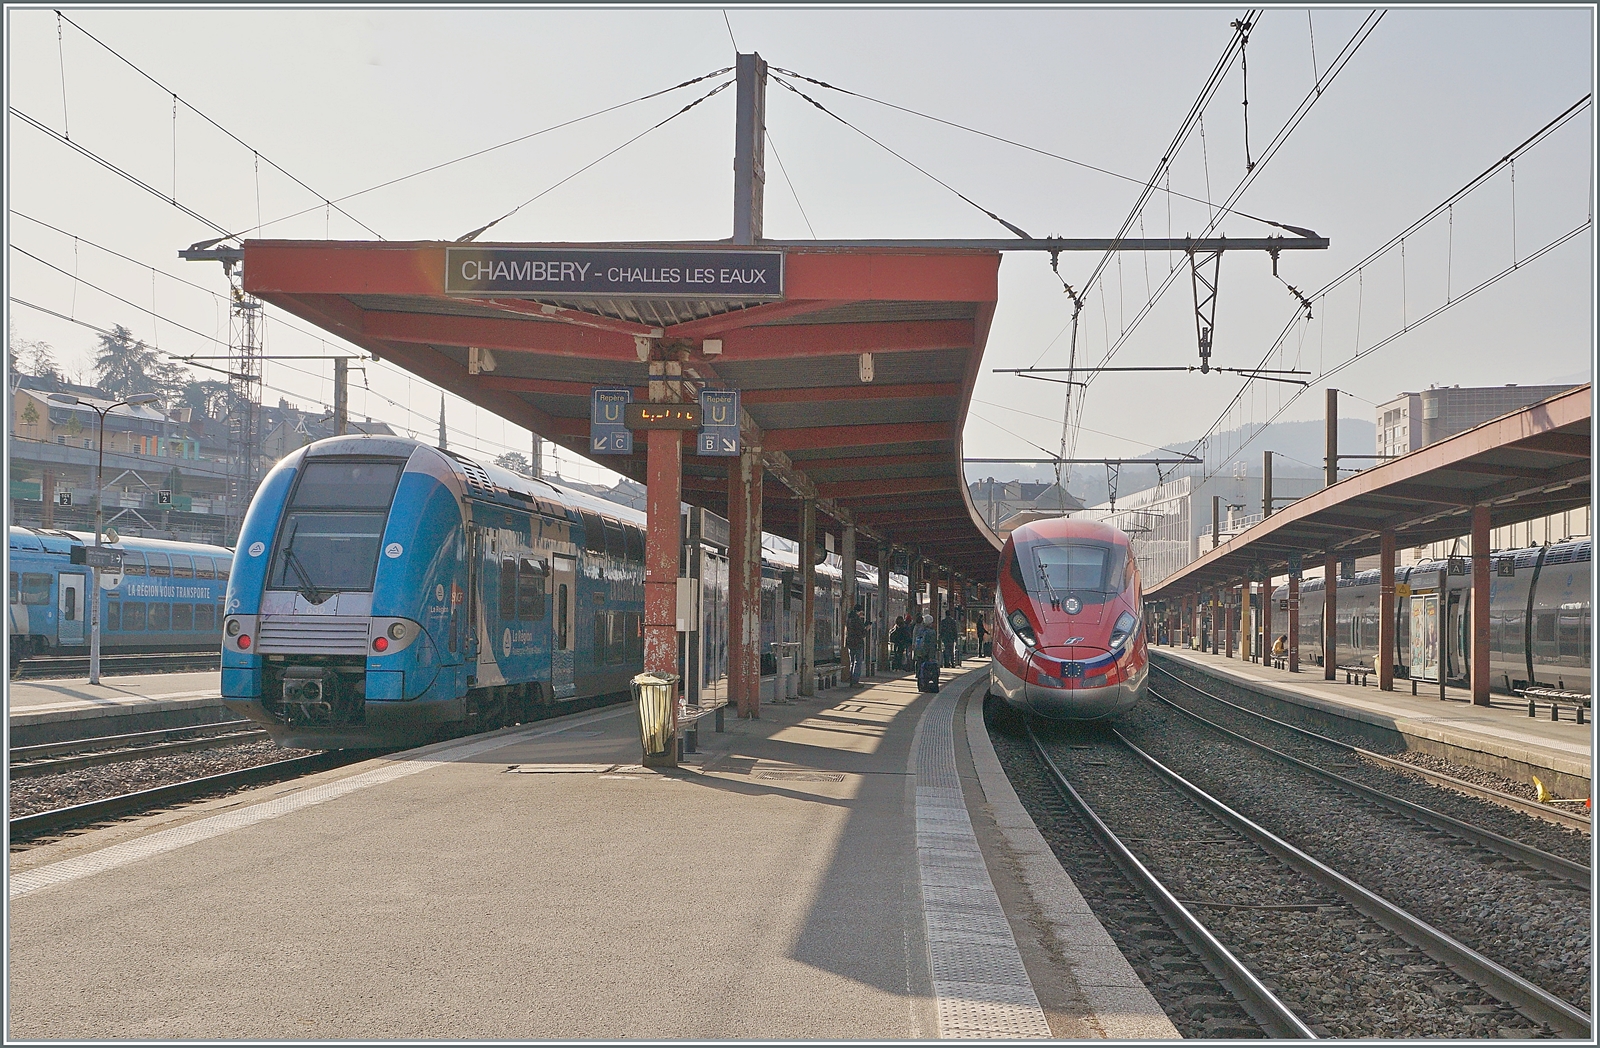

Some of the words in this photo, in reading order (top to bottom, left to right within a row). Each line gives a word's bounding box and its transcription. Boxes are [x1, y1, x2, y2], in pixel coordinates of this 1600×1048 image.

[462, 261, 591, 282] CHAMBERY
[607, 268, 681, 283] CHALLES
[685, 269, 715, 284] LES
[720, 269, 767, 284] EAUX
[600, 394, 625, 402] Repère
[706, 395, 732, 403] Repère
[605, 404, 619, 421] U
[712, 405, 726, 423] U
[615, 438, 624, 449] C
[706, 439, 714, 450] B
[1452, 565, 1460, 573] A
[1503, 566, 1509, 574] 4
[128, 584, 136, 596] LA
[136, 582, 159, 597] RÉGION
[160, 585, 175, 598] VOUS
[176, 586, 210, 599] TRANSPORTE
[306, 605, 326, 614] 630
